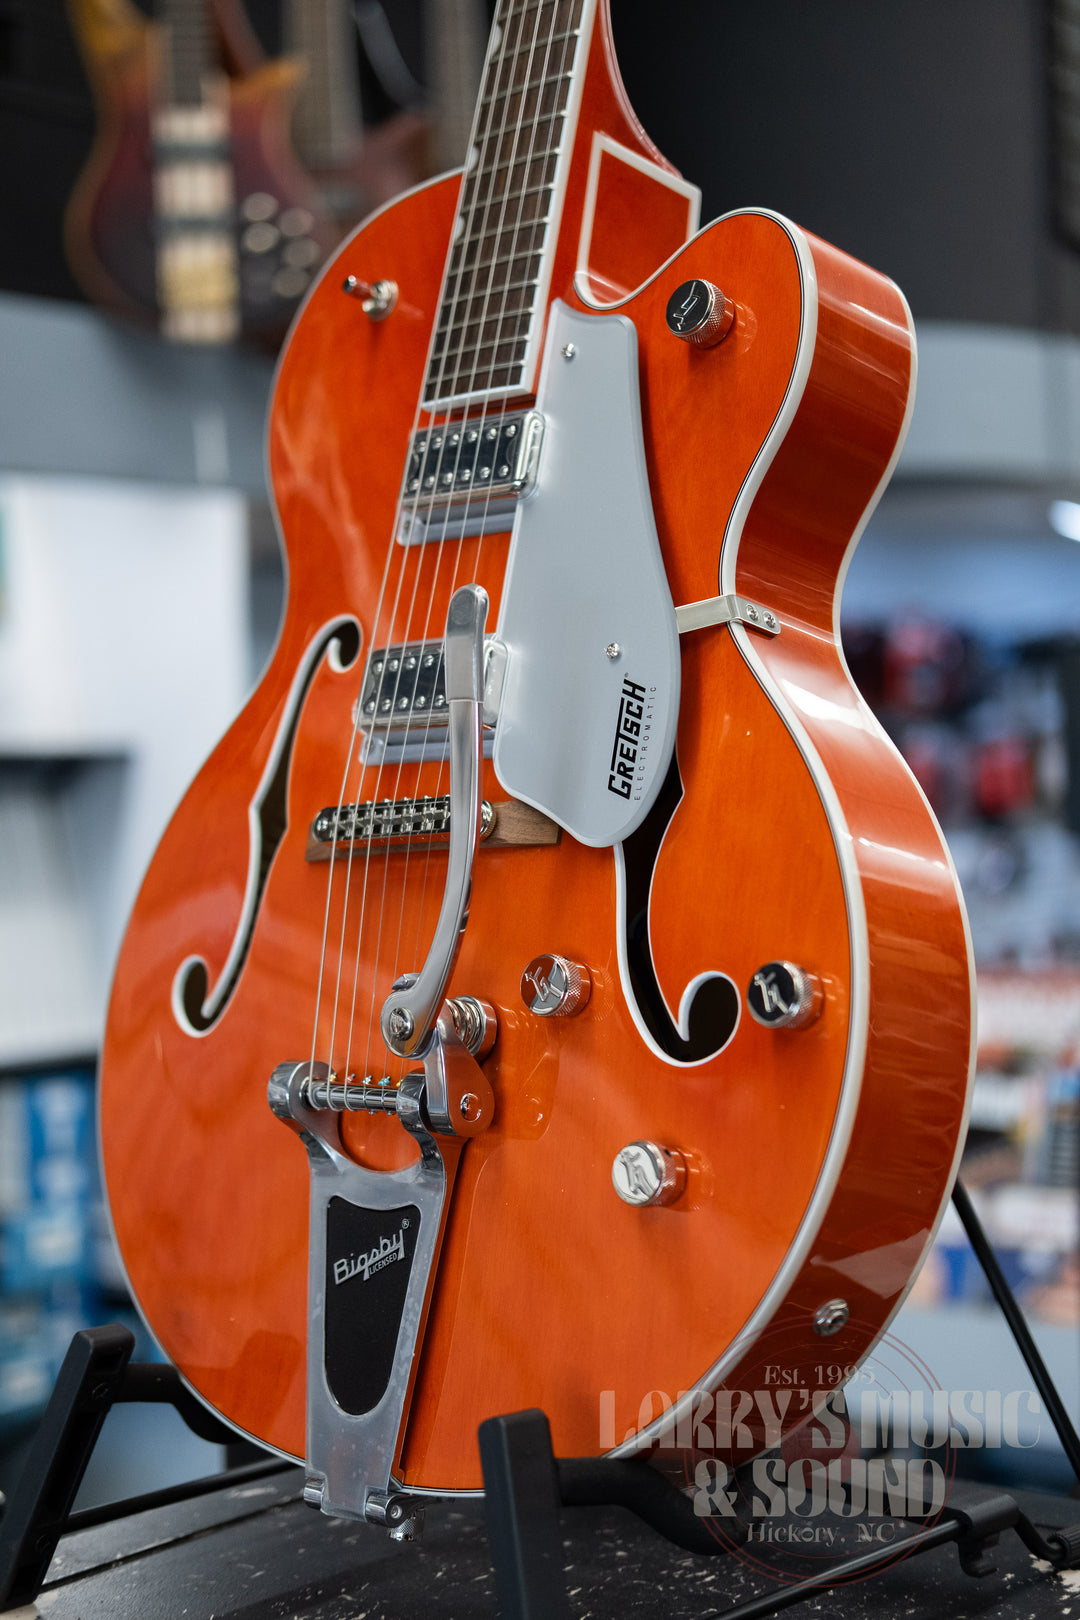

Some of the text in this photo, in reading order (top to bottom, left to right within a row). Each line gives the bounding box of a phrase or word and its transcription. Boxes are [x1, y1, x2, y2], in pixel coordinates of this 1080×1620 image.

[608, 678, 646, 800] GRETSCH
[634, 686, 656, 801] ELECTROMATIC
[369, 1252, 398, 1275] LICENSED
